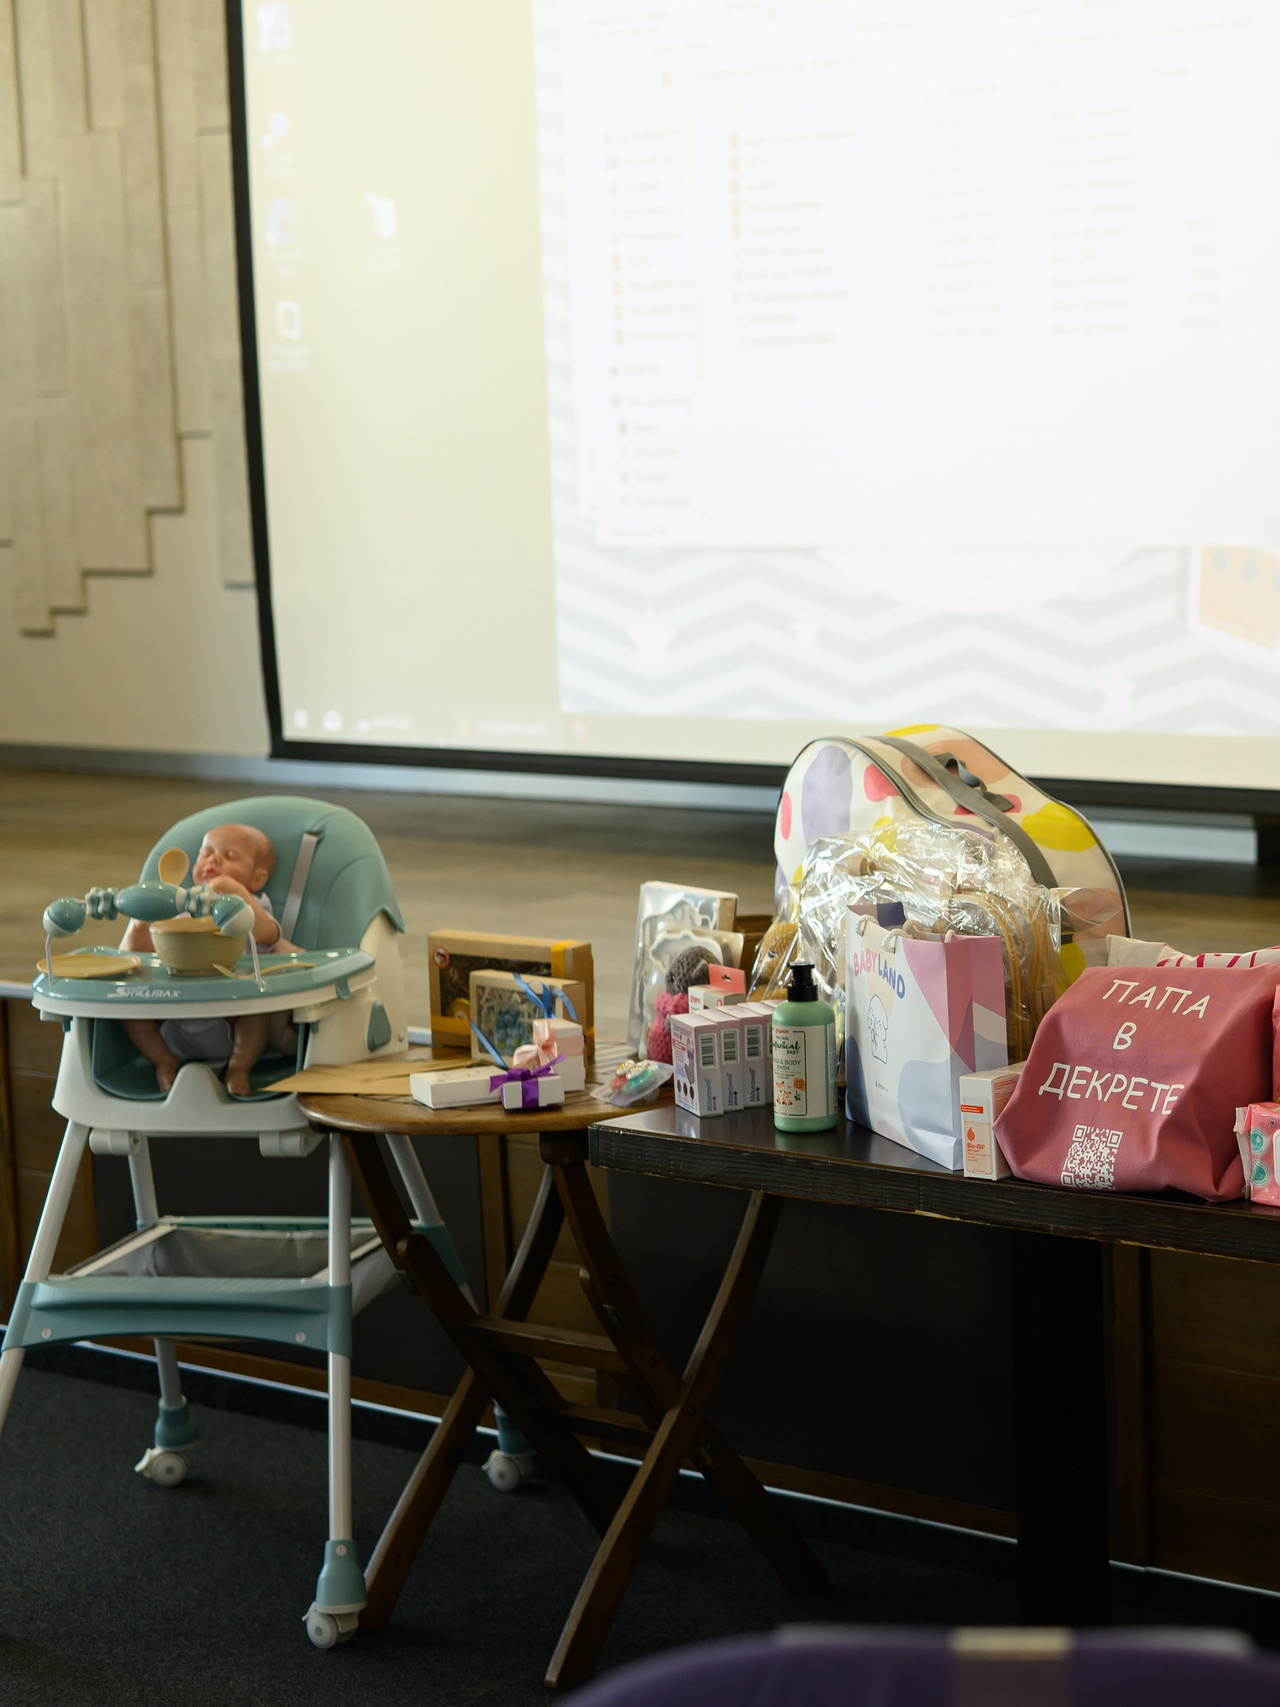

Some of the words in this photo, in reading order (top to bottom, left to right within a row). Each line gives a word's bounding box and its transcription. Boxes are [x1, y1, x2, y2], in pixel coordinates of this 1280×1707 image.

[853, 948, 878, 977] BABY
[878, 953, 906, 999] LAND
[1102, 979, 1211, 1019] ПАПА
[1113, 1021, 1137, 1051] В
[1038, 1062, 1185, 1115] ДЕКРЕТЕ
